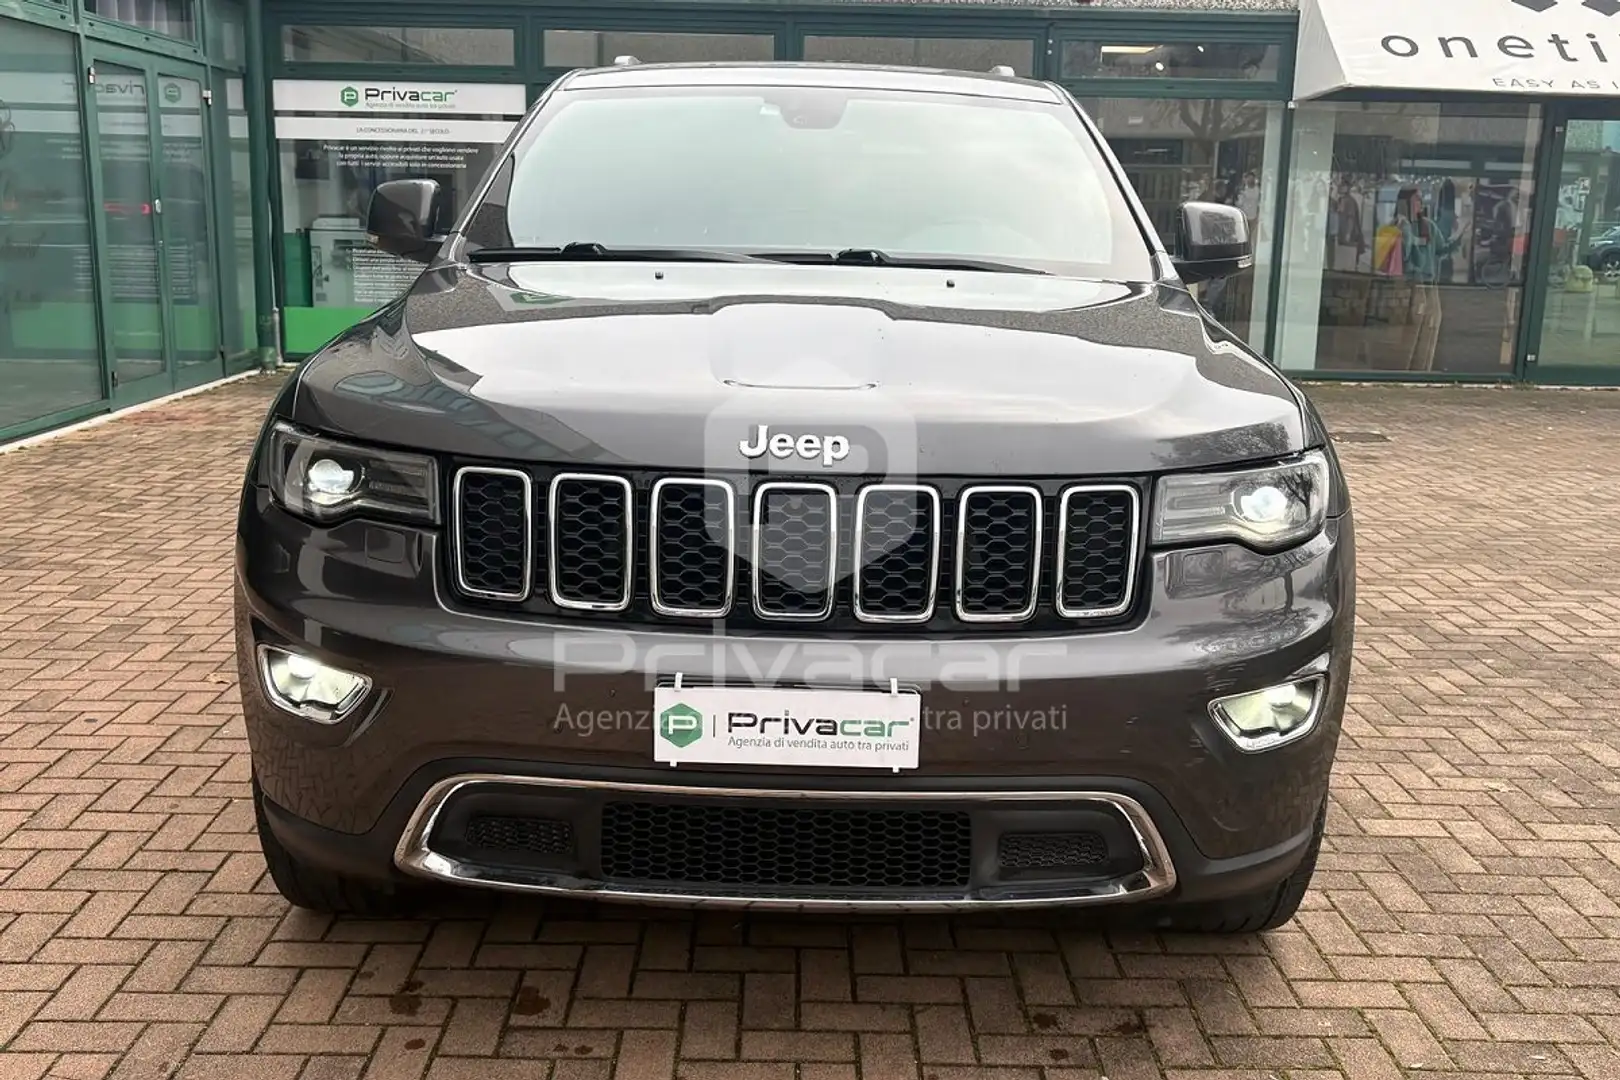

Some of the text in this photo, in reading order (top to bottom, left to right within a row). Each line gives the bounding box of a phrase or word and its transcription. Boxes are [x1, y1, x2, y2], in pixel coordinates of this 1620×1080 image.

[1492, 78, 1554, 88] EASY
[1571, 80, 1600, 89] AS
[365, 87, 455, 102] Privacar
[738, 424, 850, 468] Jeep
[728, 710, 910, 738] Privacar
[727, 736, 909, 753] Agenzia di vendita auto tra privati
